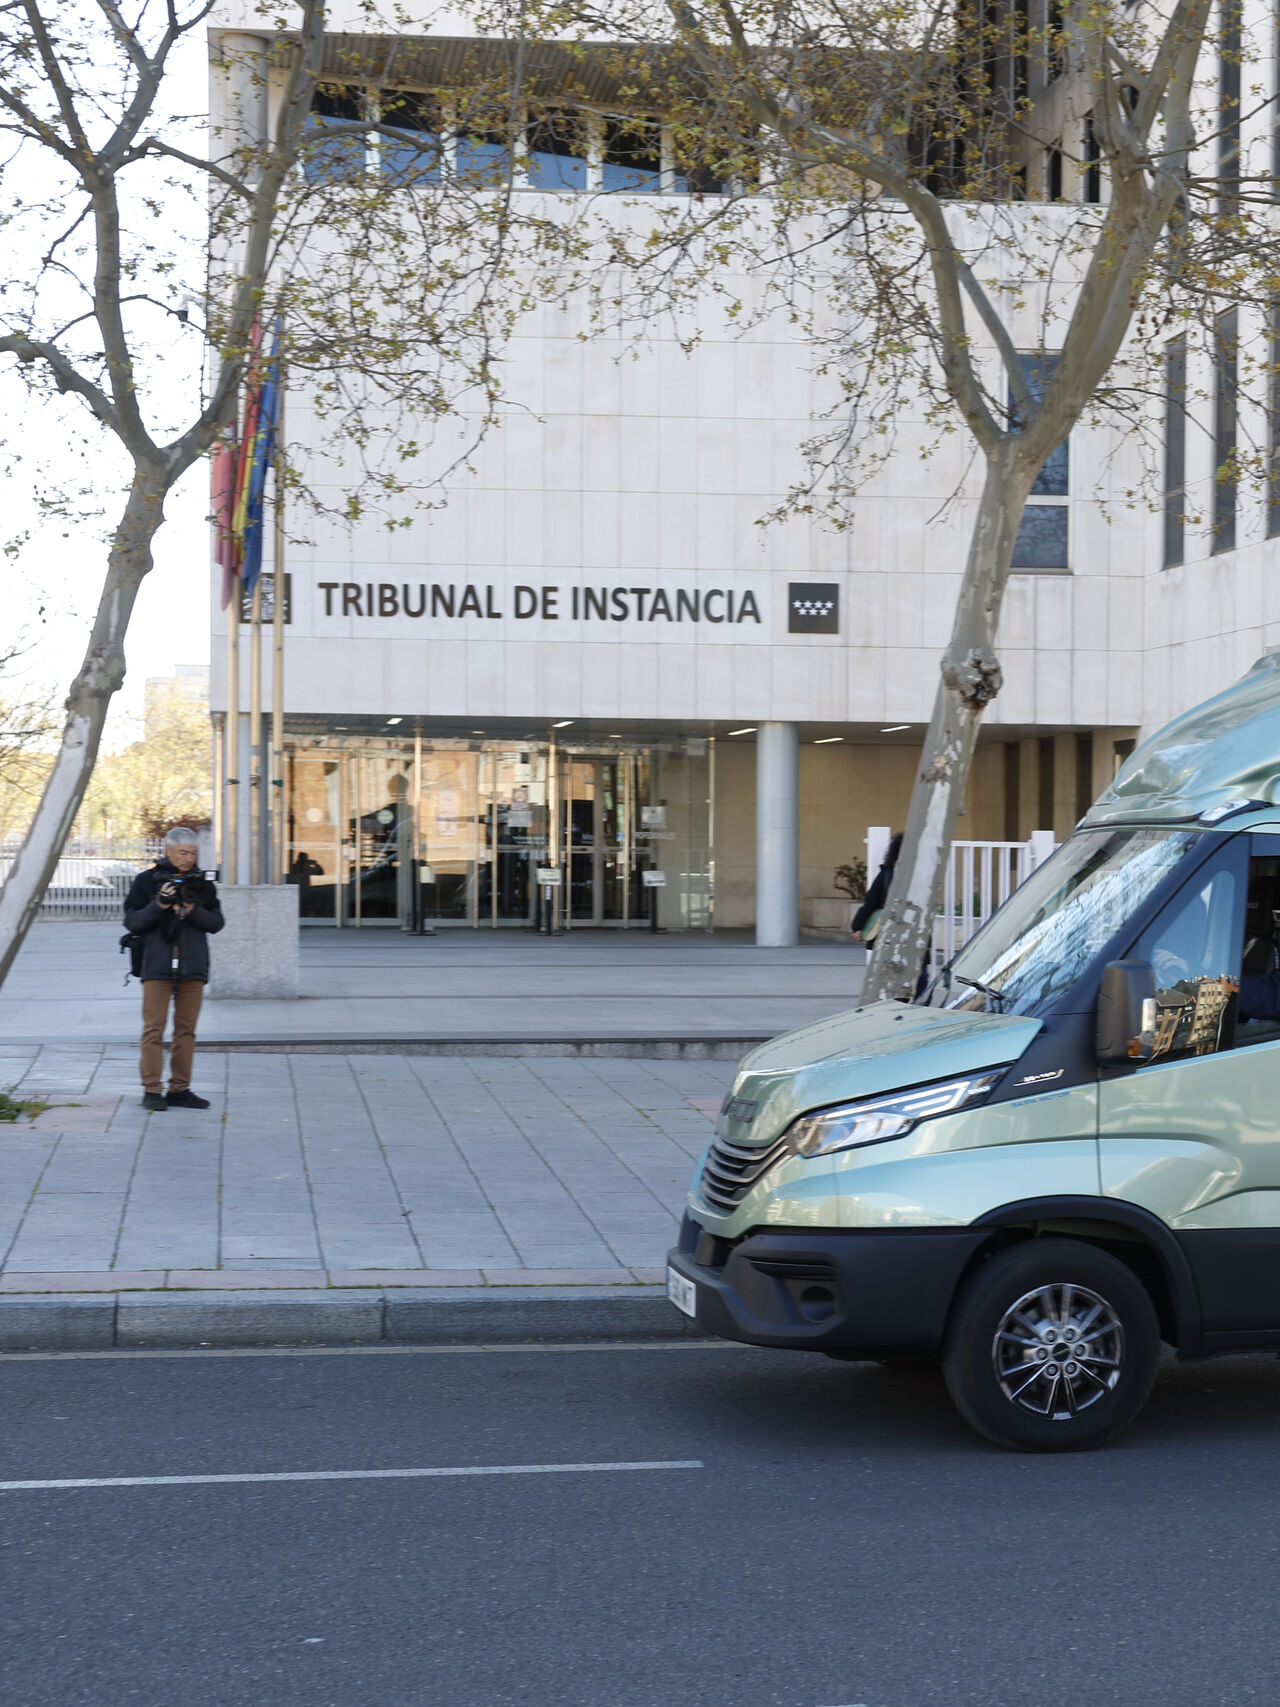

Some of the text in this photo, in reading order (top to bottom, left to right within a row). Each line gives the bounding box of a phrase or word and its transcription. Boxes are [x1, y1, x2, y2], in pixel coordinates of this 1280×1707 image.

[318, 582, 761, 624] TRIBUNAL DE INSTANCIA
